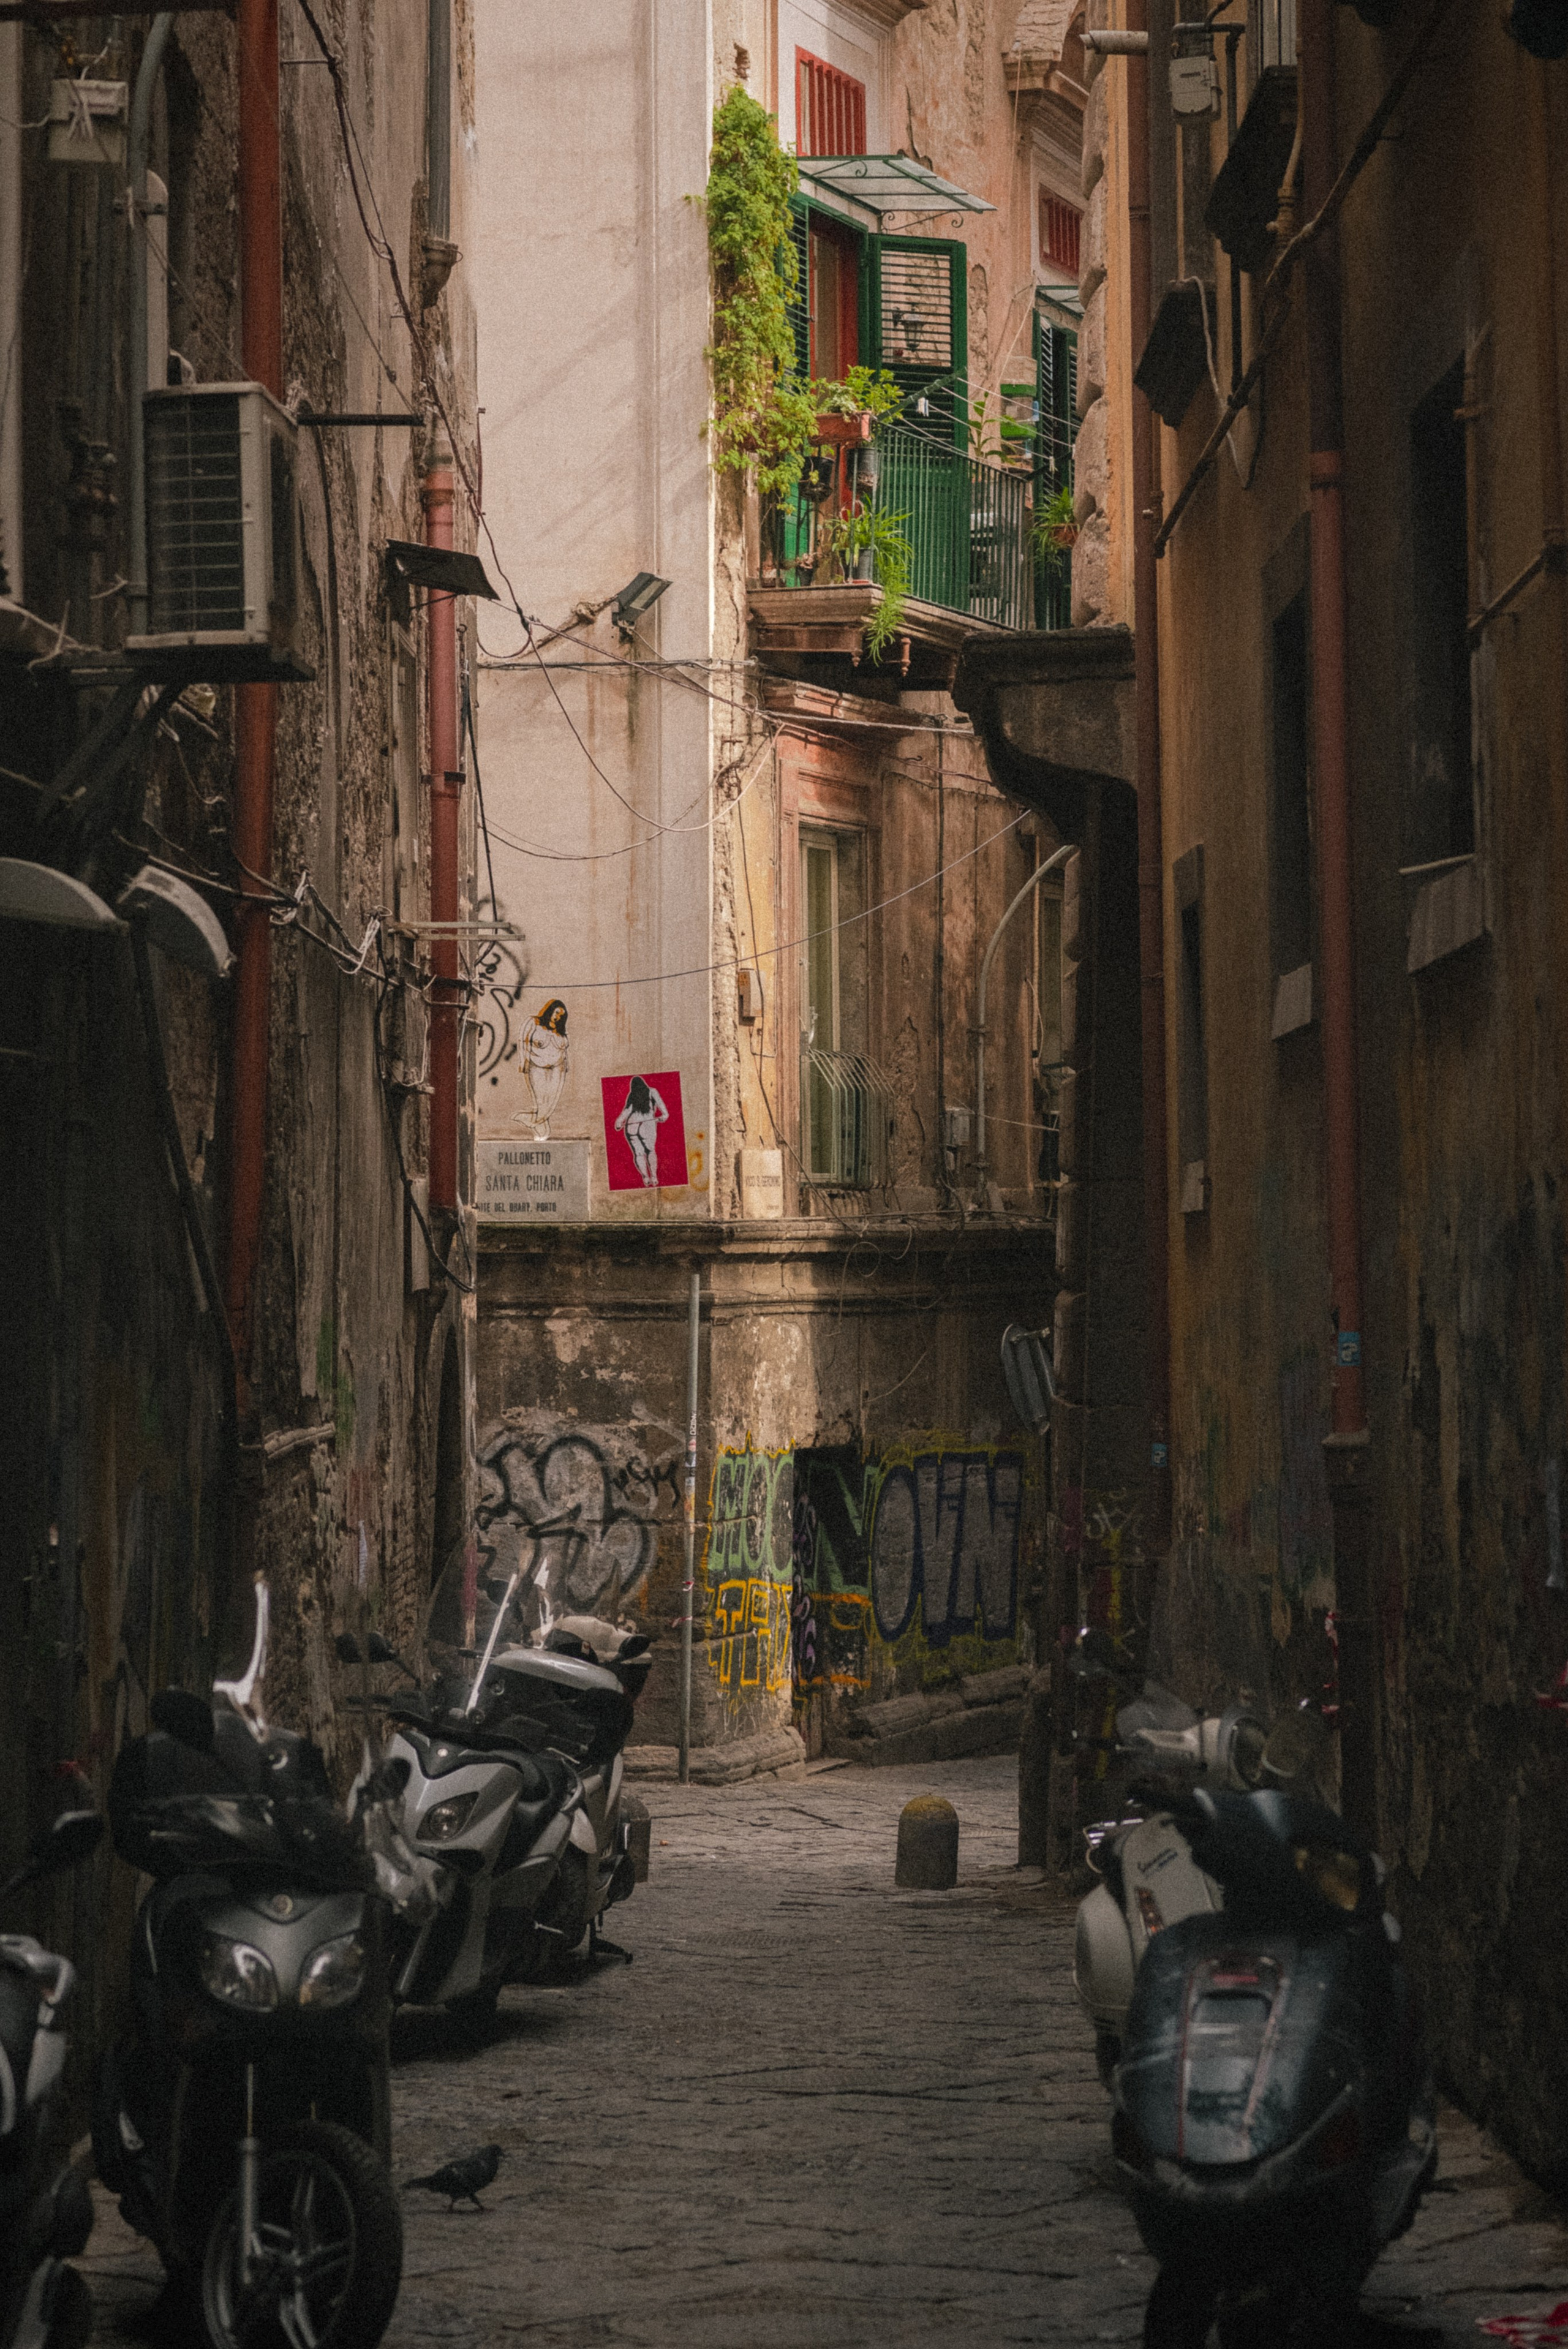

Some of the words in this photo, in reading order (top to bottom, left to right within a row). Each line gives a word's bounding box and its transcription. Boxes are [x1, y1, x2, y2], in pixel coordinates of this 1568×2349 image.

[498, 1152, 551, 1165] PALLONETTO
[485, 1174, 520, 1191] SANTA
[526, 1174, 565, 1191] CHIARA
[494, 1202, 505, 1213] DEL
[536, 1202, 557, 1213] PORTO
